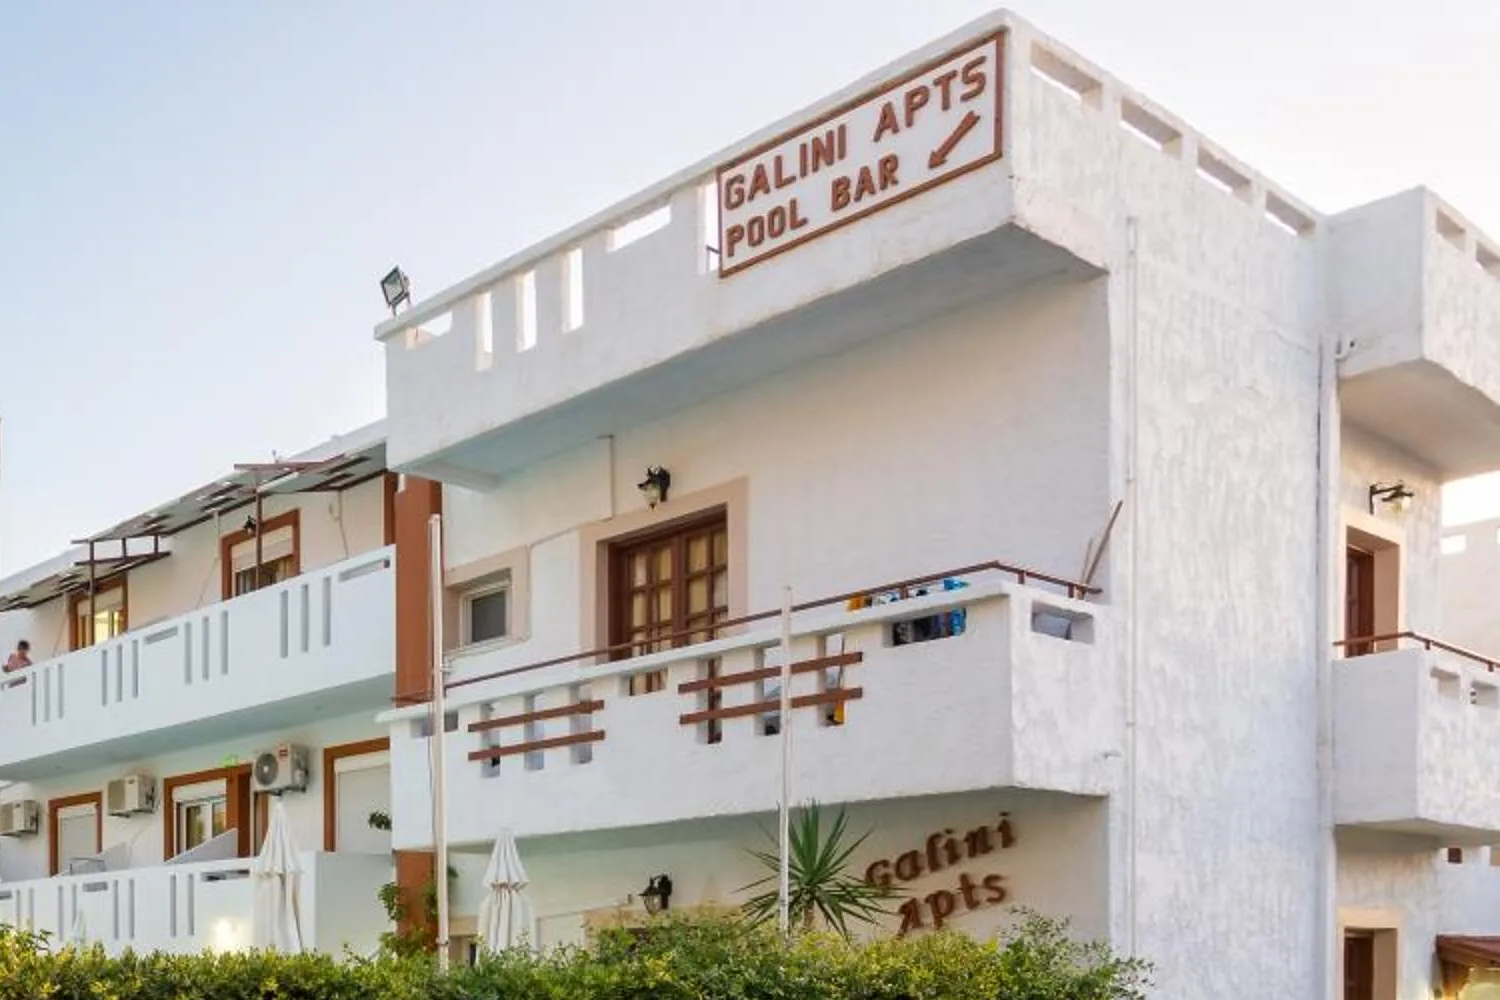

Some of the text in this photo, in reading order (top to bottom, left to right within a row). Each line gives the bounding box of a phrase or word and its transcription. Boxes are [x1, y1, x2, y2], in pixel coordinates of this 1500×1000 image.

[723, 55, 987, 211] GALINI APTS
[725, 153, 900, 257] POOL BAR
